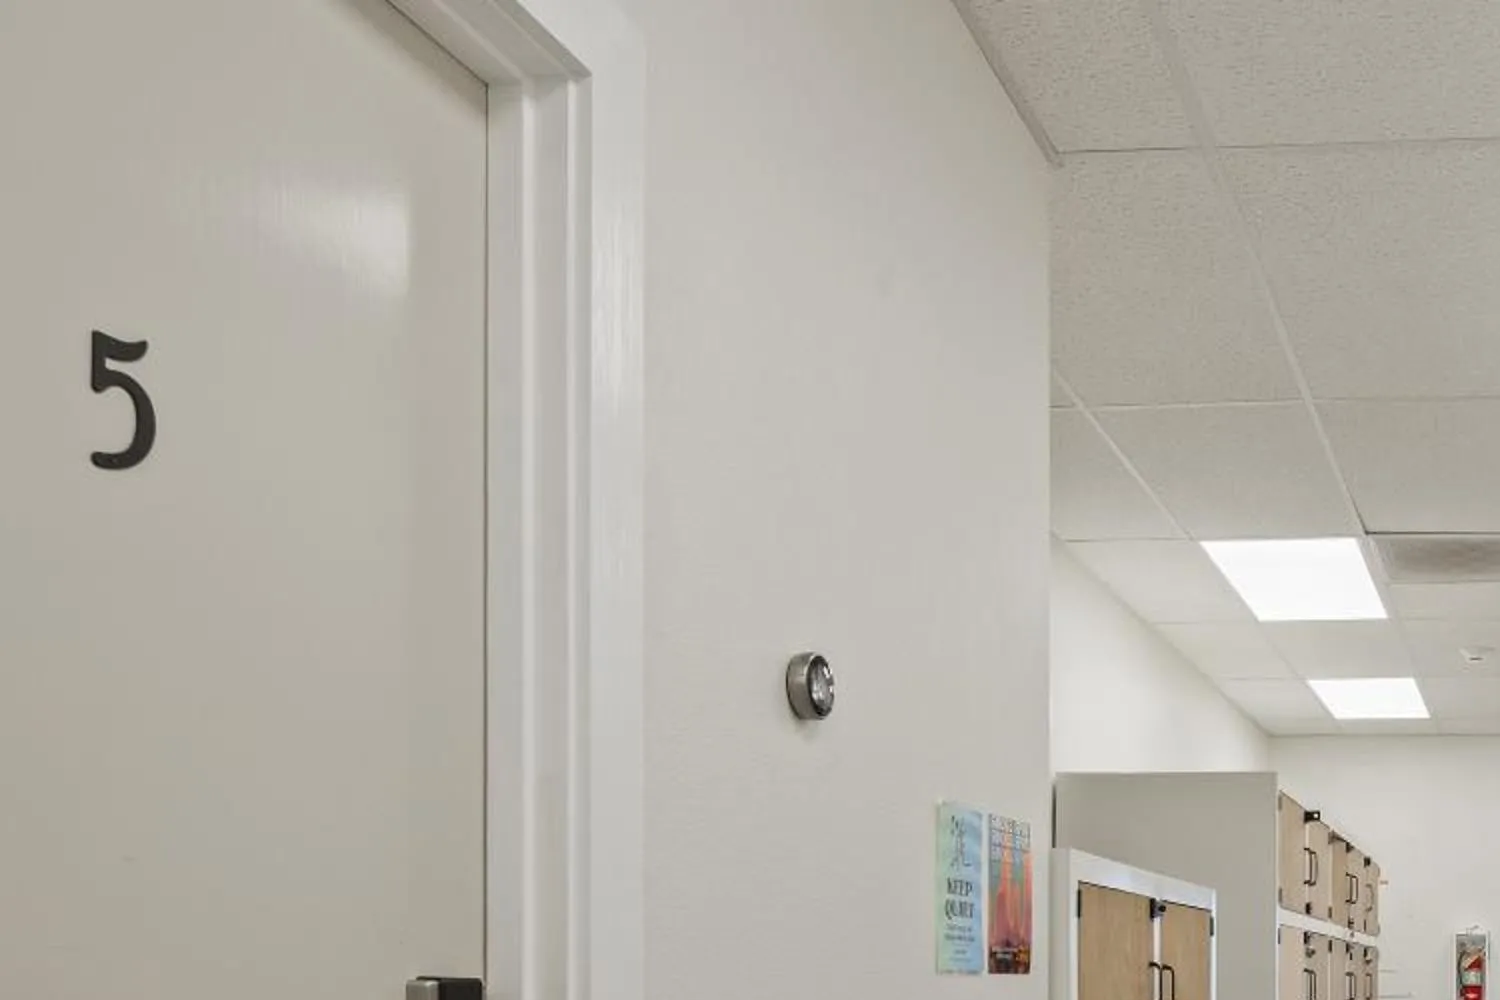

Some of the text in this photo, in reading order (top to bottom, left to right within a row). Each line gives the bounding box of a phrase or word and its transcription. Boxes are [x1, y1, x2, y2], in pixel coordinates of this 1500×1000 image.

[90, 329, 156, 470] 5
[946, 878, 973, 897] KEEP
[944, 899, 975, 920] QUIET
